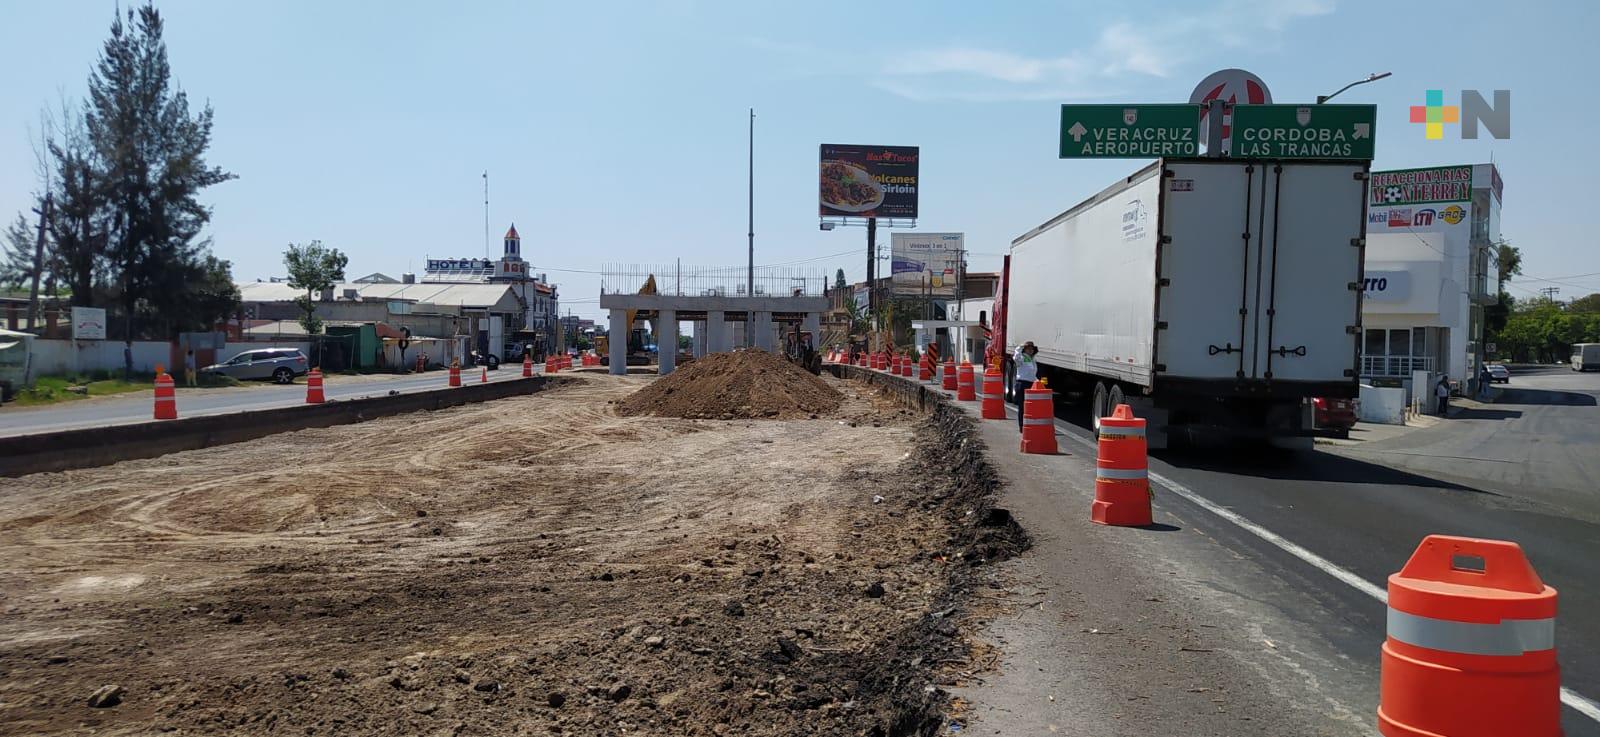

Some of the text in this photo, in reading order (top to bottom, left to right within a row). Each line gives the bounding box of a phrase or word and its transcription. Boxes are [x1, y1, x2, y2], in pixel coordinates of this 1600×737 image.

[1093, 128, 1192, 141] VERACRUZ
[1243, 128, 1346, 141] CORDOBA
[1081, 142, 1194, 154] AEROPUERTO
[1241, 143, 1352, 156] LAS TRANCAS
[1373, 168, 1470, 186] REFACCIONARIAS
[881, 184, 915, 193] Sirloin
[1369, 212, 1388, 223] Mobil
[1414, 212, 1433, 226] LTH
[429, 261, 479, 269] HOTEL
